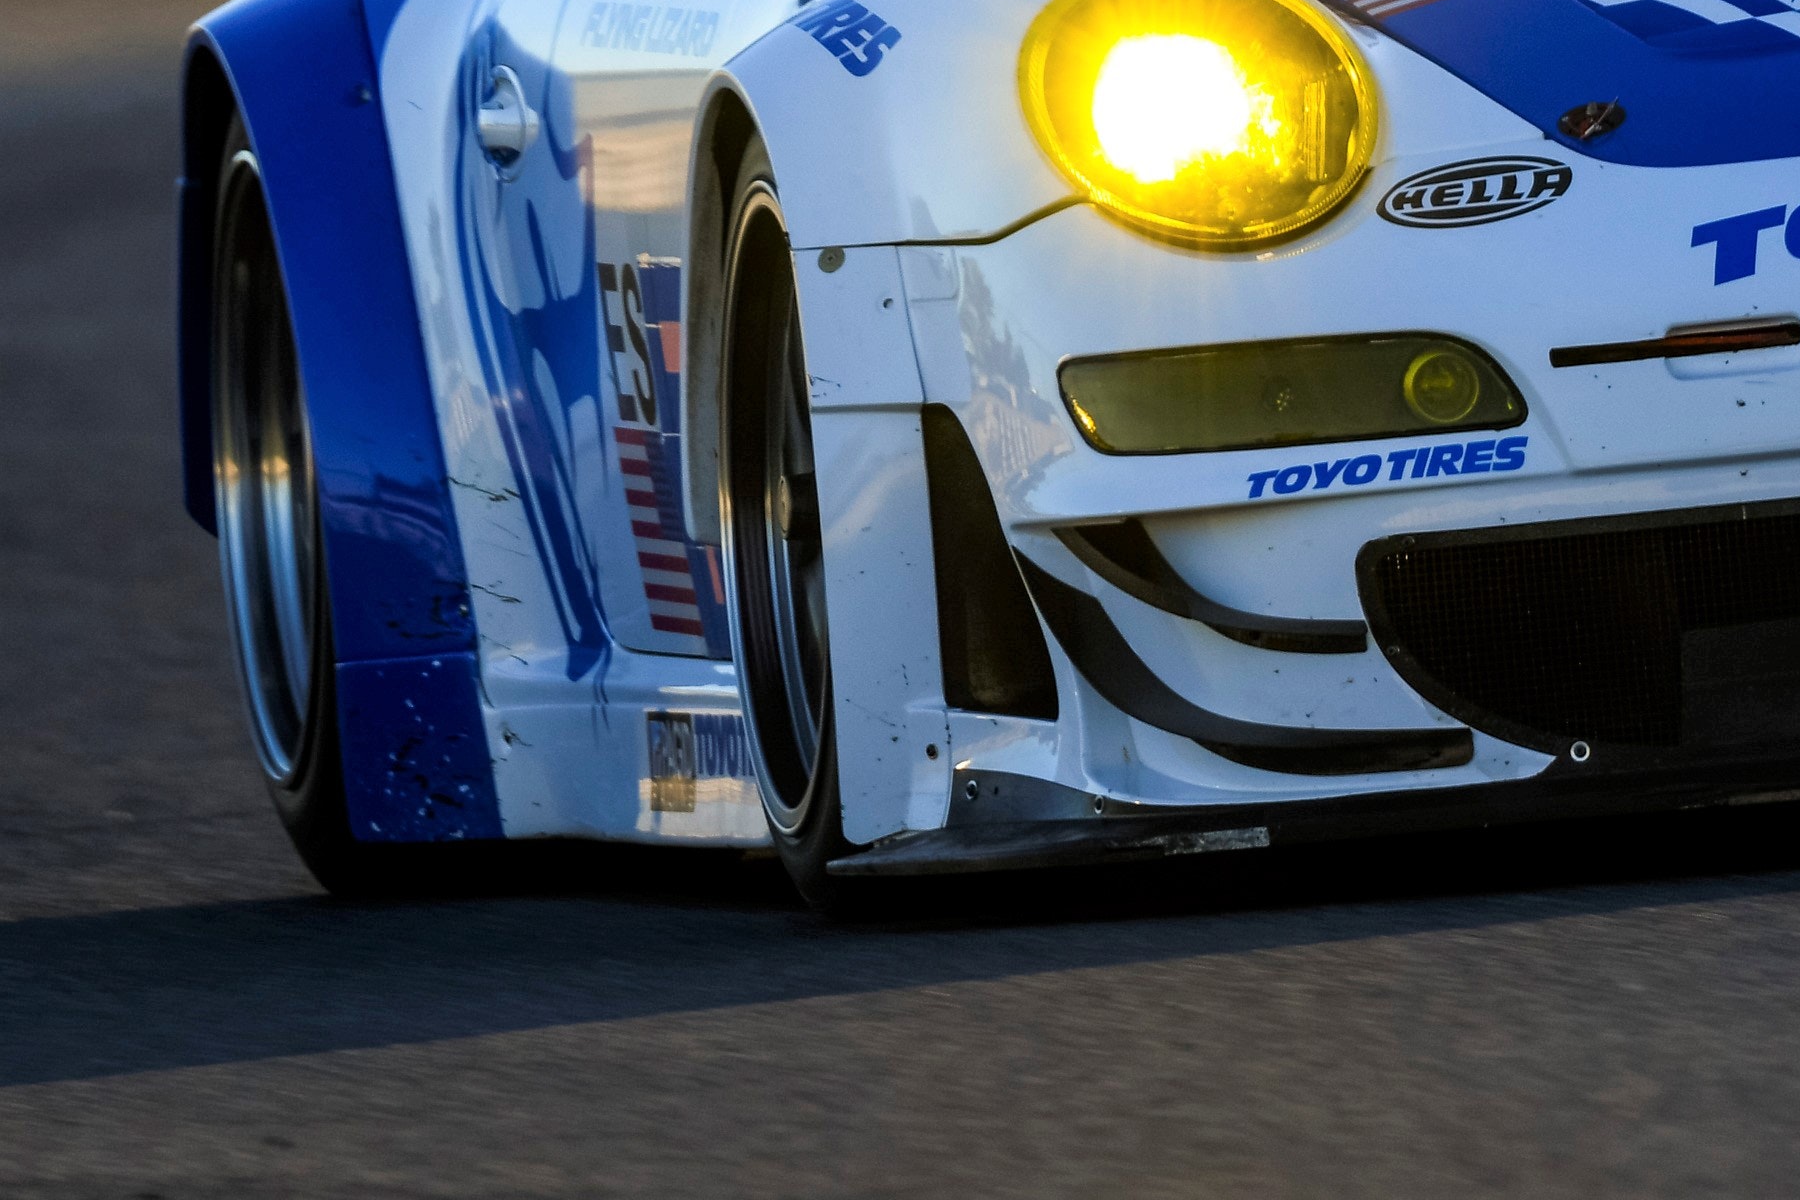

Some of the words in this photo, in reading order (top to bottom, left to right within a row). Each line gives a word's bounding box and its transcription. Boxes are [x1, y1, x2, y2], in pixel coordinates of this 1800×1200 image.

[580, 2, 653, 52] FLYING
[644, 6, 720, 57] LIZARD
[1391, 165, 1572, 212] HELLA
[1246, 453, 1383, 499] TOYO
[1385, 436, 1529, 483] TIRES
